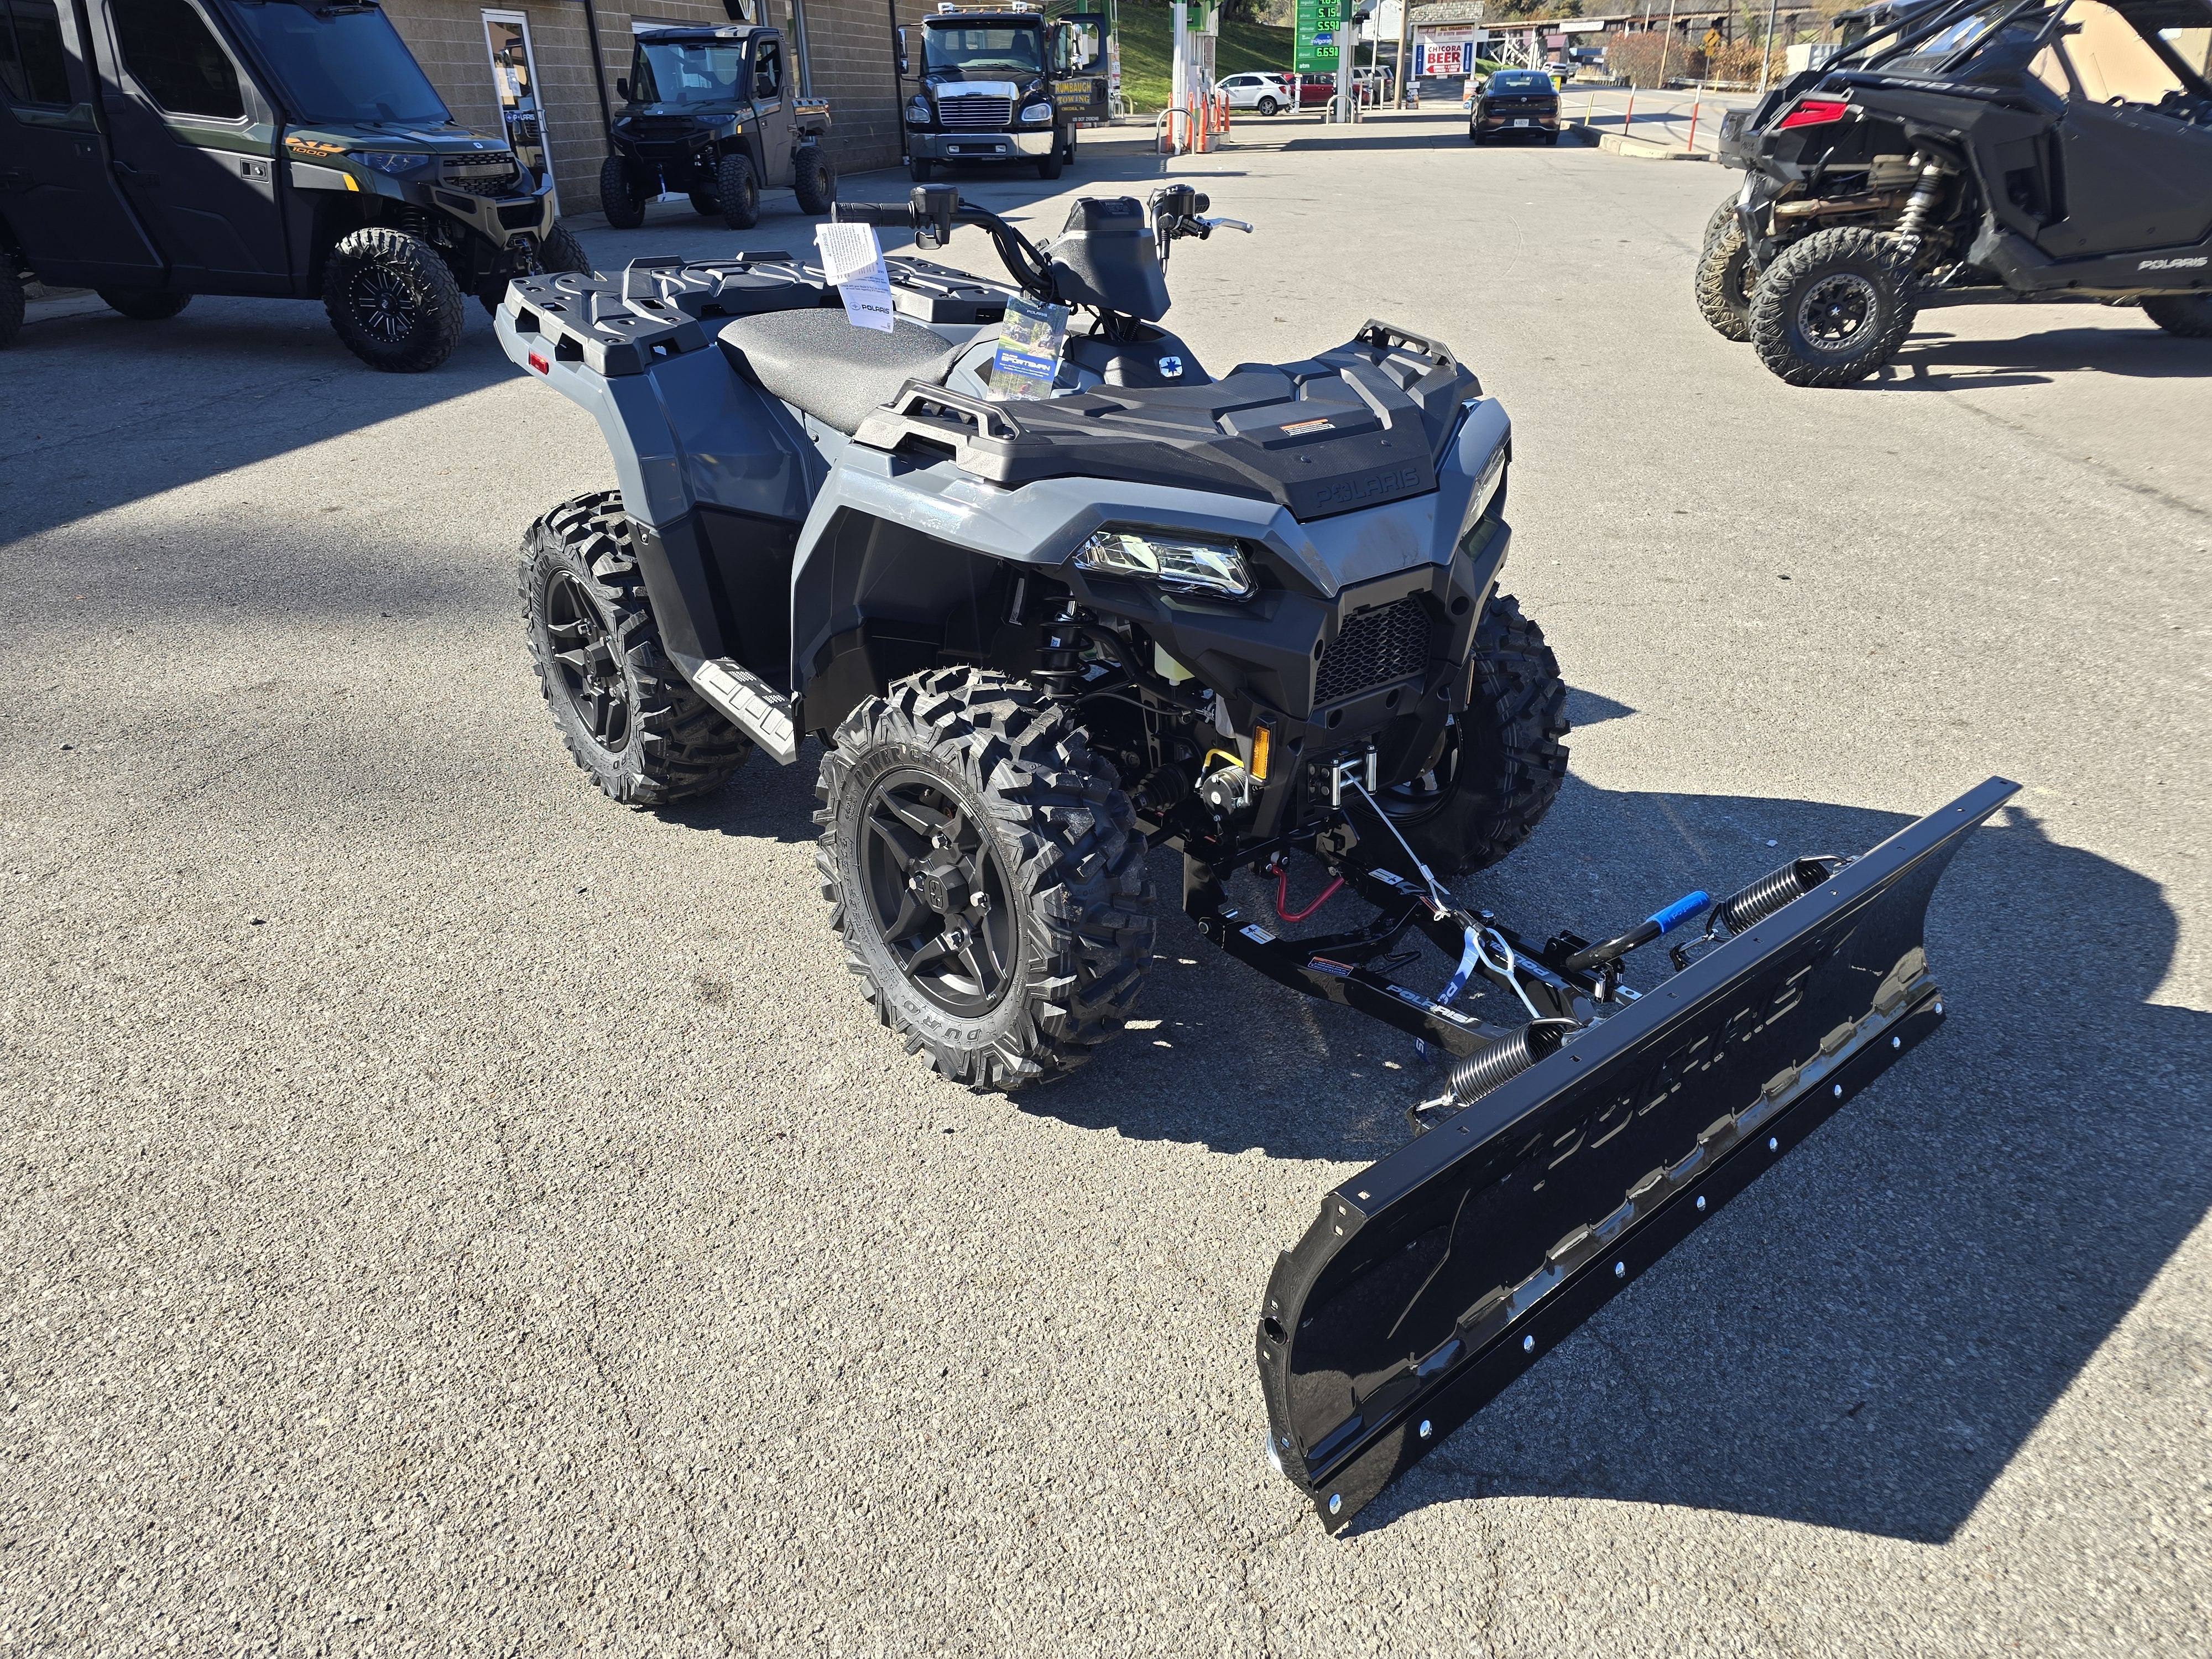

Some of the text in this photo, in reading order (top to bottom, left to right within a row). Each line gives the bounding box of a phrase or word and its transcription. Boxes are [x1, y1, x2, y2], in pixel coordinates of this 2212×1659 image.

[1428, 52, 1460, 64] BEER
[1056, 81, 1091, 93] RUMBAUGH
[1880, 77, 1955, 90] PRO
[1057, 95, 1090, 104] TOWING
[289, 136, 339, 148] XP
[293, 147, 327, 158] 1000
[2137, 257, 2208, 270] POLARIS
[862, 304, 890, 314] POLARIS
[1026, 309, 1048, 317] POLARIS
[1001, 355, 1051, 371] SPORTSMAN
[1316, 467, 1421, 508] POLARIS
[854, 747, 954, 790] POWER GRIP
[1386, 984, 1469, 1023] POLARIS
[904, 999, 982, 1042] DURO
